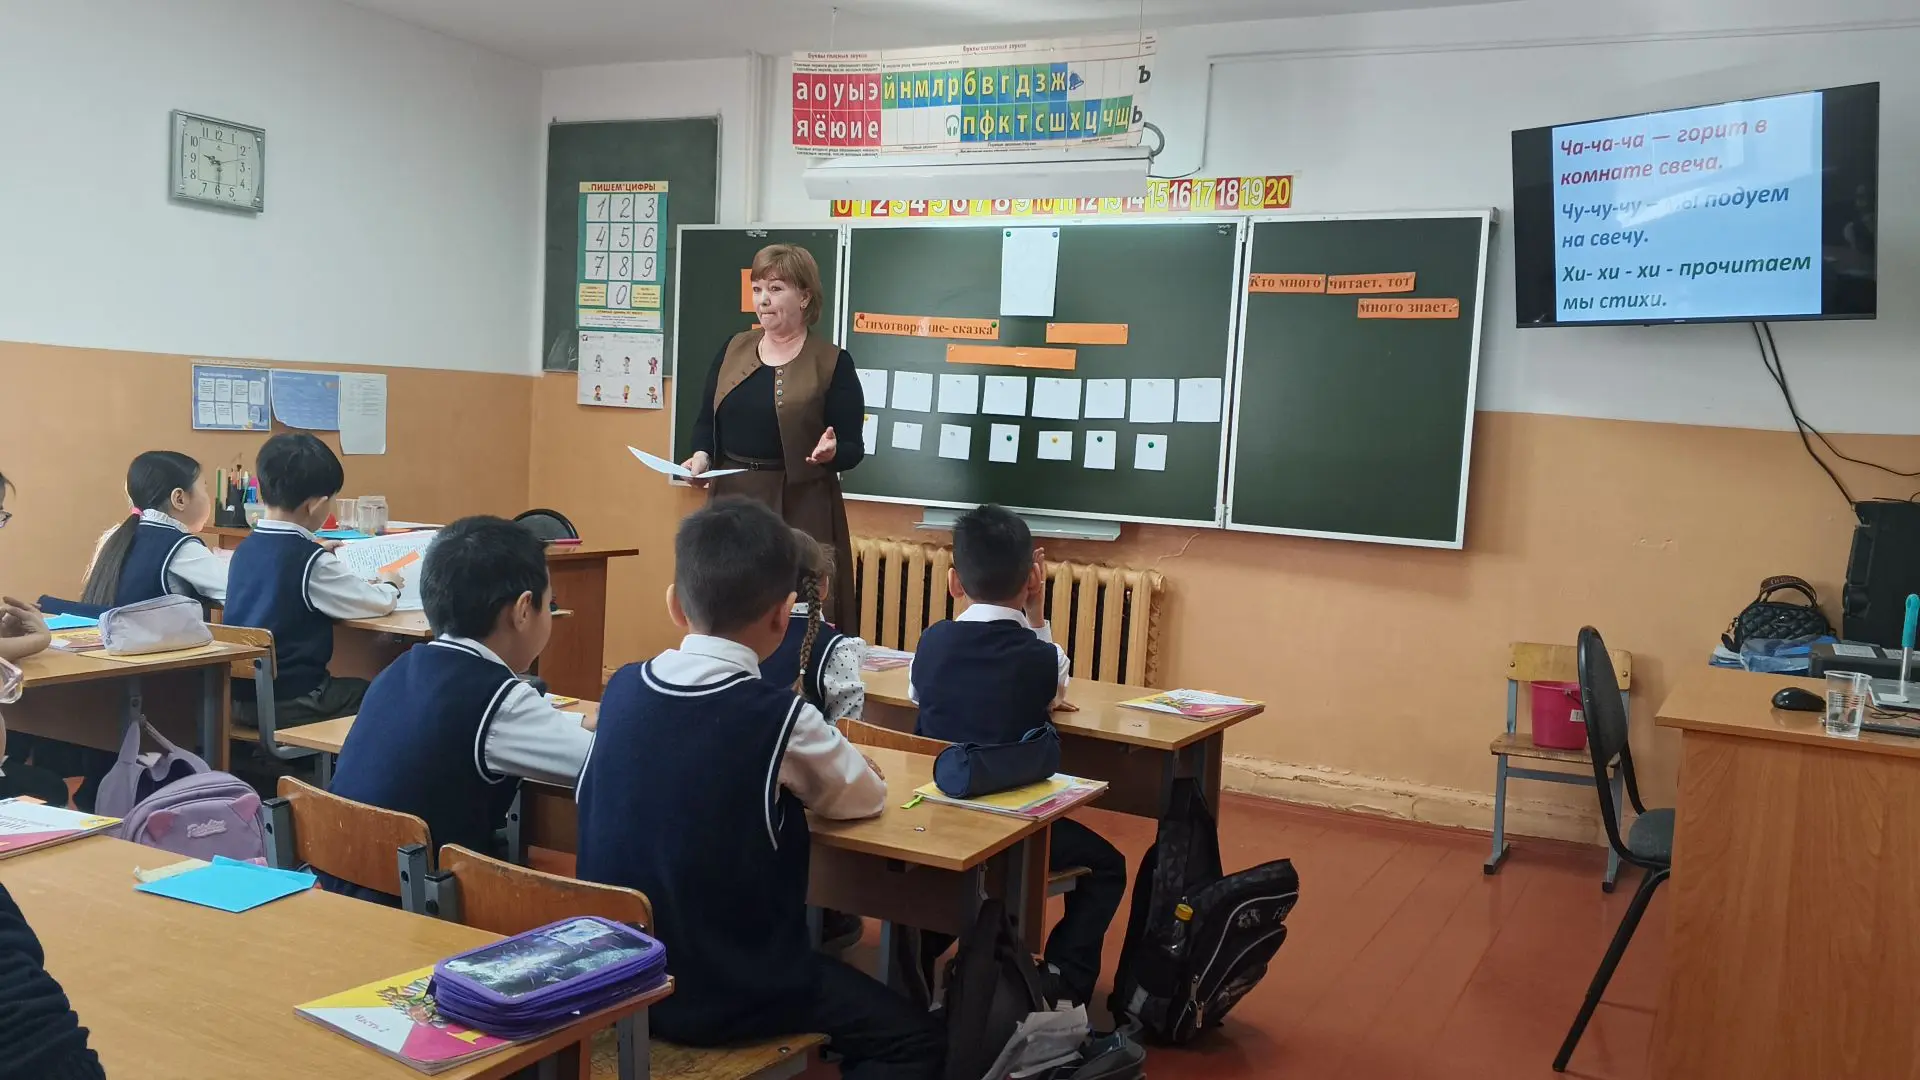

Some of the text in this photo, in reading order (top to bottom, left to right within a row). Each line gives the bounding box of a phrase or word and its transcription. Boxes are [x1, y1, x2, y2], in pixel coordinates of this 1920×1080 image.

[796, 65, 1151, 107] а о у ы э й н м л р б в г д з ж ъ
[796, 105, 1143, 140] я ё ю и е п ф к т с ш х ц ч щ ь
[202, 127, 209, 138] 11
[215, 129, 223, 140] 12
[1560, 132, 1644, 156] Ча-ча-ча
[1677, 119, 1748, 144] горит
[1755, 119, 1768, 133] в
[190, 135, 246, 156] 10 2
[190, 152, 197, 163] 9
[190, 169, 245, 189] 8 4
[1560, 154, 1723, 186] комнате свеча.
[202, 182, 208, 193] 7
[229, 187, 235, 198] 5
[591, 183, 656, 192] ПИШЕМ ЦИФРЫ
[1147, 181, 1169, 208] 15
[1170, 181, 1192, 208] 16
[1193, 180, 1216, 208] 17
[1216, 179, 1239, 206] 18
[1241, 178, 1264, 206] 19
[1265, 177, 1290, 206] 20
[597, 197, 655, 218] 1 2 3
[1562, 199, 1642, 223] Чу-чу-чу
[1704, 186, 1789, 209] подуем
[595, 226, 654, 248] 4 5 6
[1562, 229, 1649, 248] на свечу.
[594, 255, 654, 278] 7 8 9
[1562, 265, 1593, 282] Хи-
[1597, 266, 1620, 281] хи
[1637, 264, 1661, 278] хи
[1679, 255, 1812, 280] прочитаем
[1250, 275, 1322, 289] Кто много
[1388, 276, 1414, 288] тот
[615, 284, 628, 305] 0
[1563, 292, 1668, 310] мы стихи.
[1359, 302, 1454, 314] много знает.
[855, 318, 993, 336] Стихотворие- сказка
